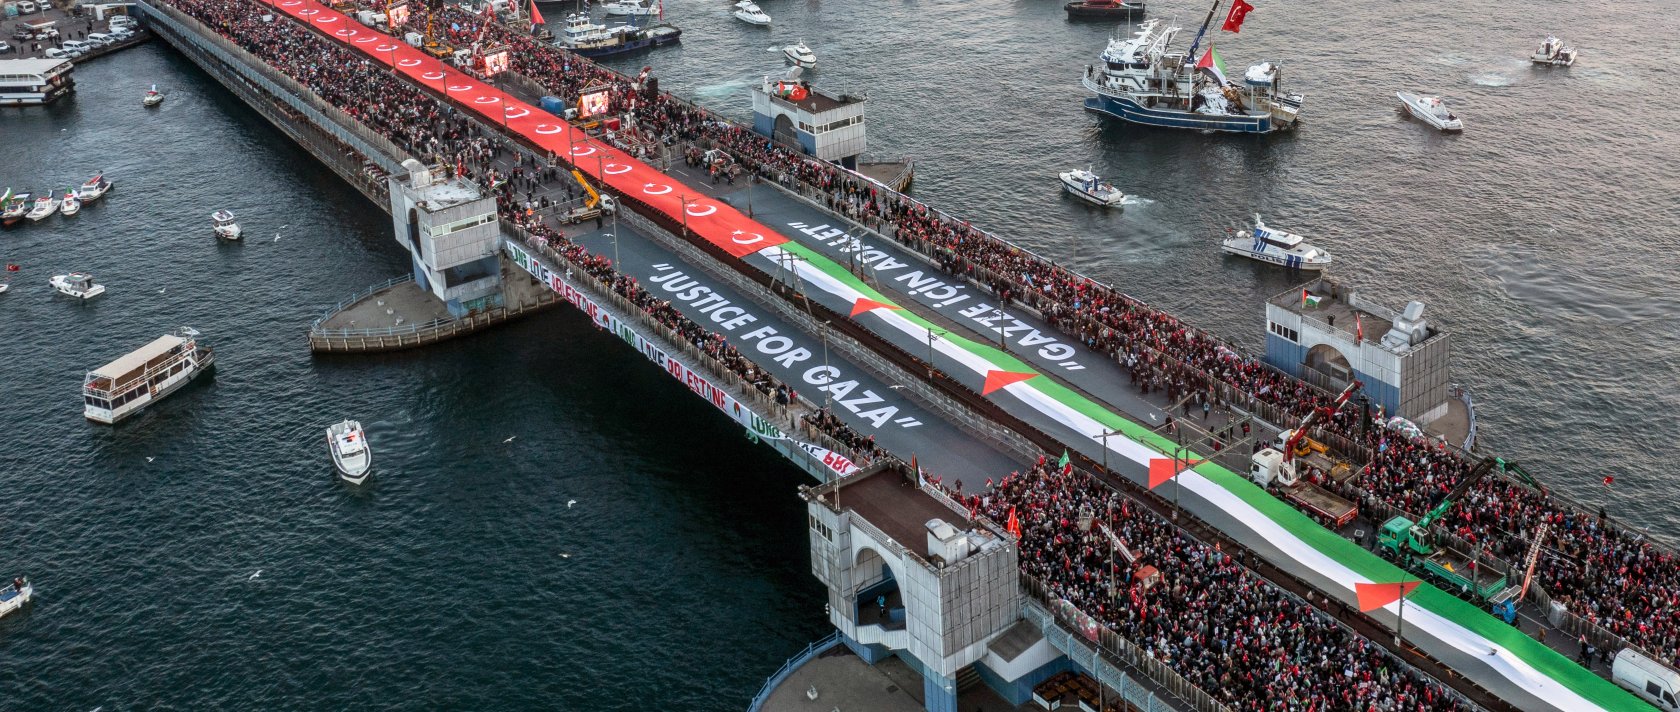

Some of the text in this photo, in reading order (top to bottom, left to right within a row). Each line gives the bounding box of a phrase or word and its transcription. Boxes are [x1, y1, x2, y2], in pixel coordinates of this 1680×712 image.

[894, 270, 971, 308] İÇİN
[649, 263, 923, 429] "JUSTICE FOR GAZA"
